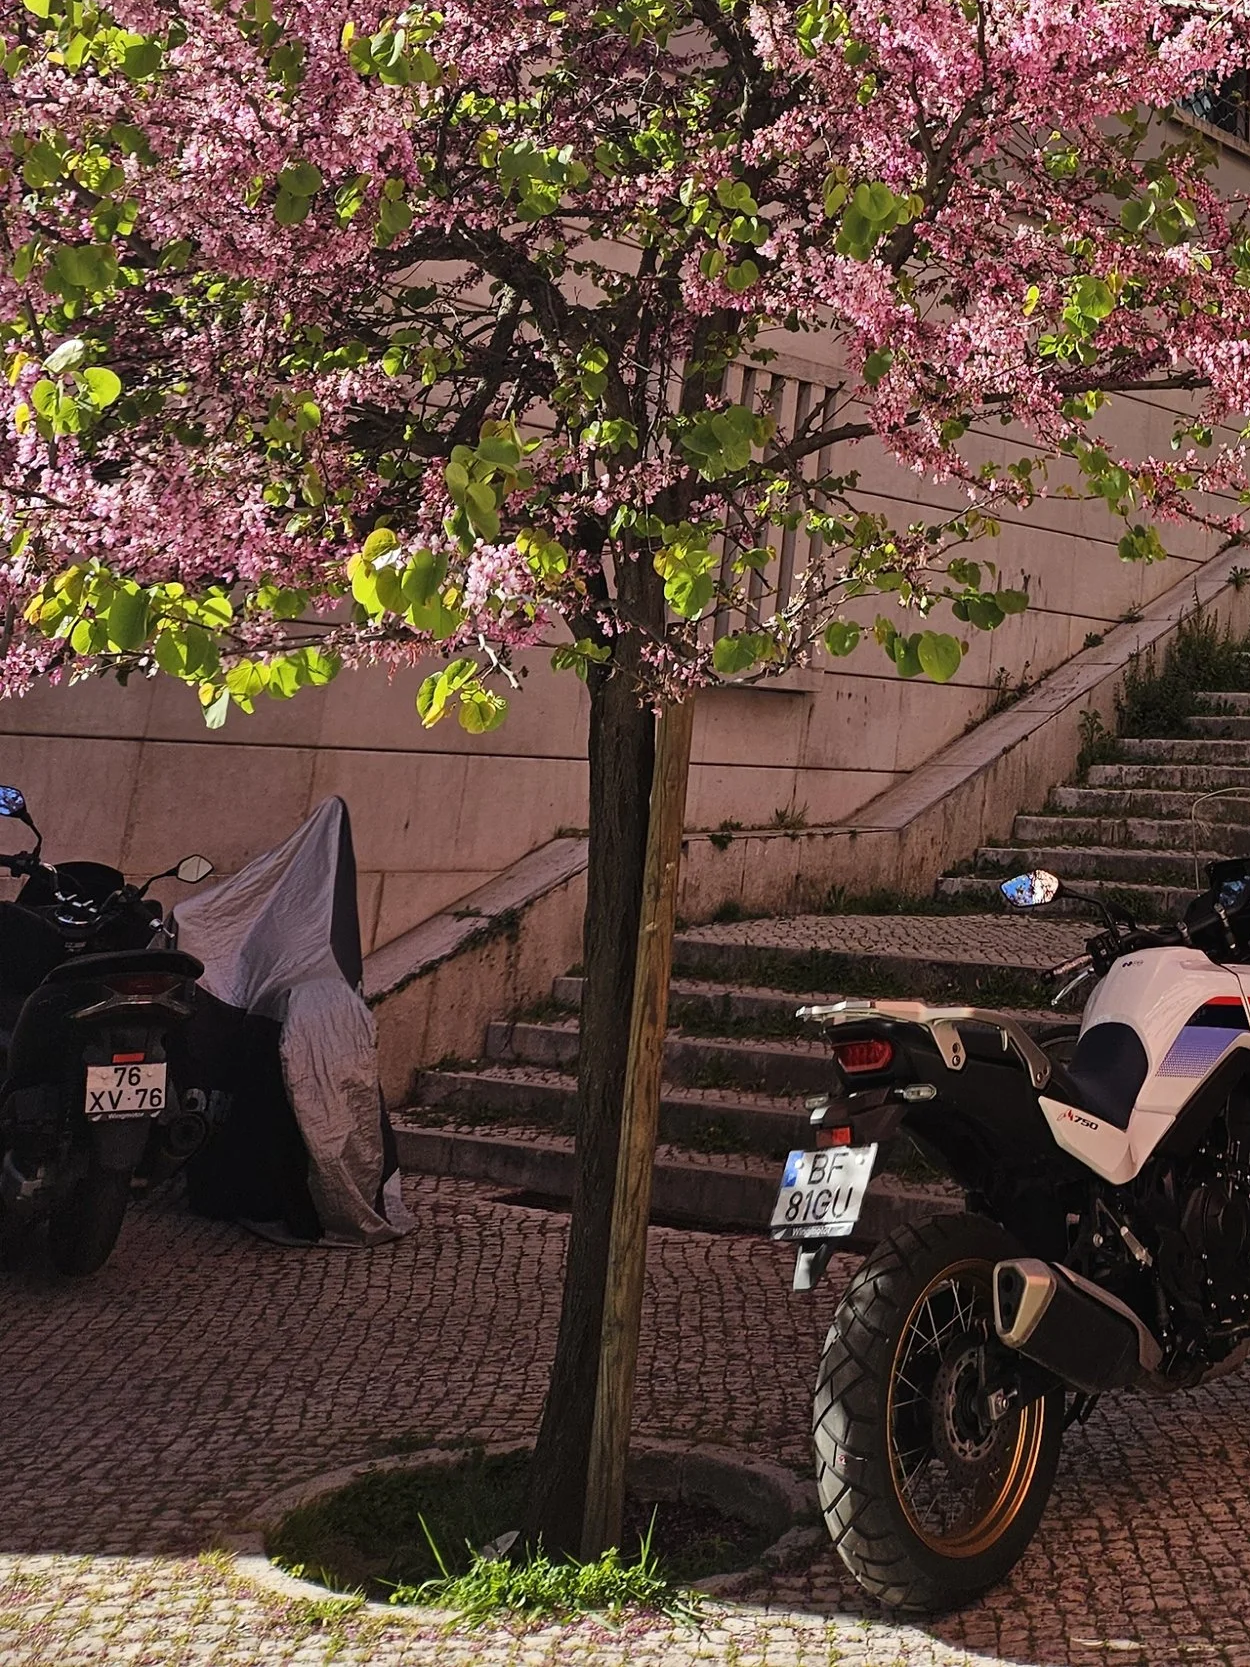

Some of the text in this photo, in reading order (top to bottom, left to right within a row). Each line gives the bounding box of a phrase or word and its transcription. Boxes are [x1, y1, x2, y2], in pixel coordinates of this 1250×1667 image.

[114, 1067, 141, 1087] 76
[108, 1112, 145, 1120] Wingmotor
[807, 1152, 849, 1185] BF
[785, 1186, 854, 1222] 81GU
